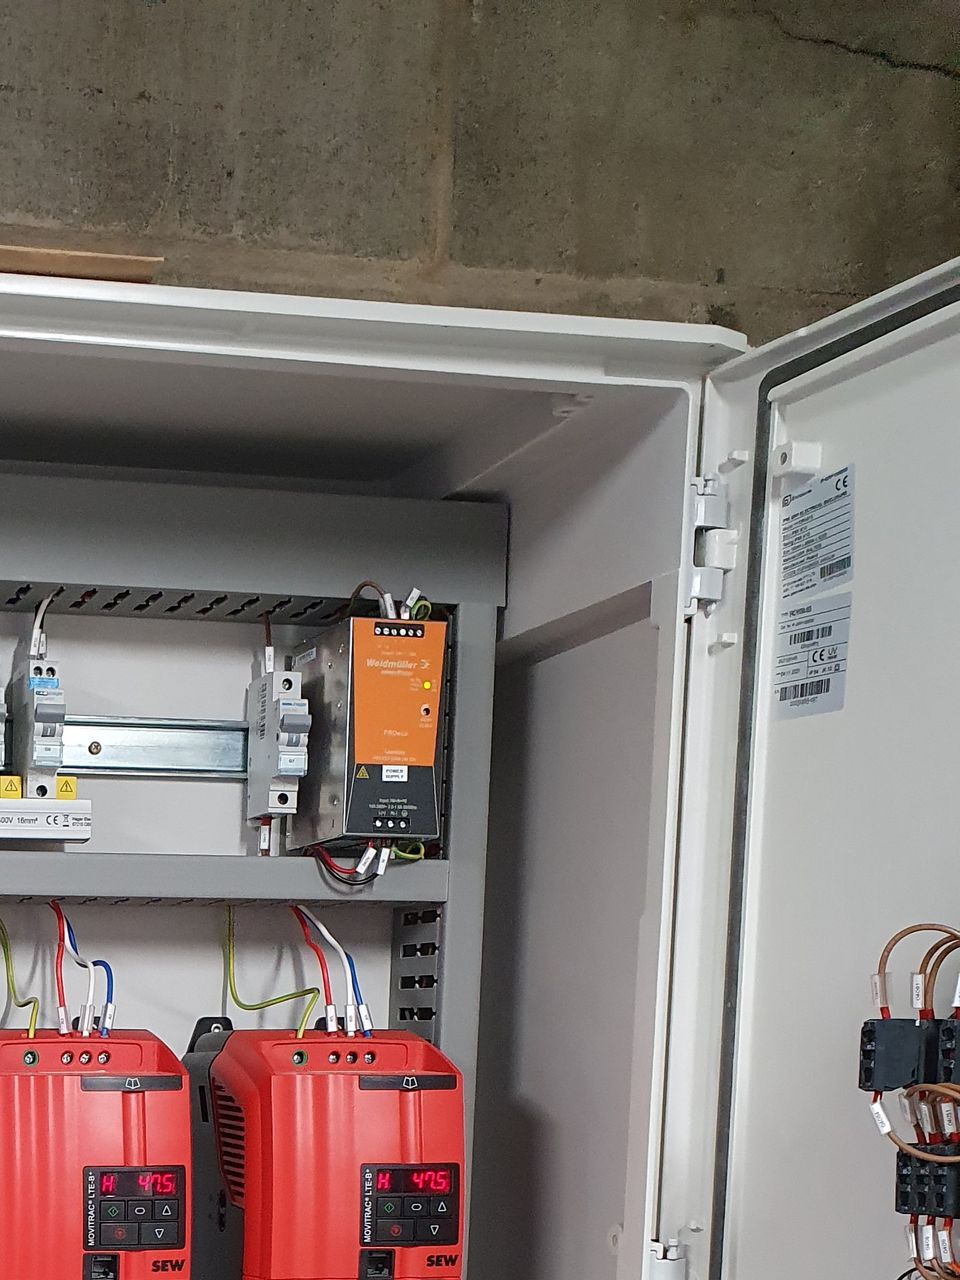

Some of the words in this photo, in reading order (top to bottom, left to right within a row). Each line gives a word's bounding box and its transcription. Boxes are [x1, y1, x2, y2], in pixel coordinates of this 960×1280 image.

[366, 658, 417, 668] Weidmüller
[102, 1176, 114, 1191] H
[378, 1172, 389, 1189] H
[152, 1260, 185, 1272] SEW
[426, 1255, 459, 1266] SEW
